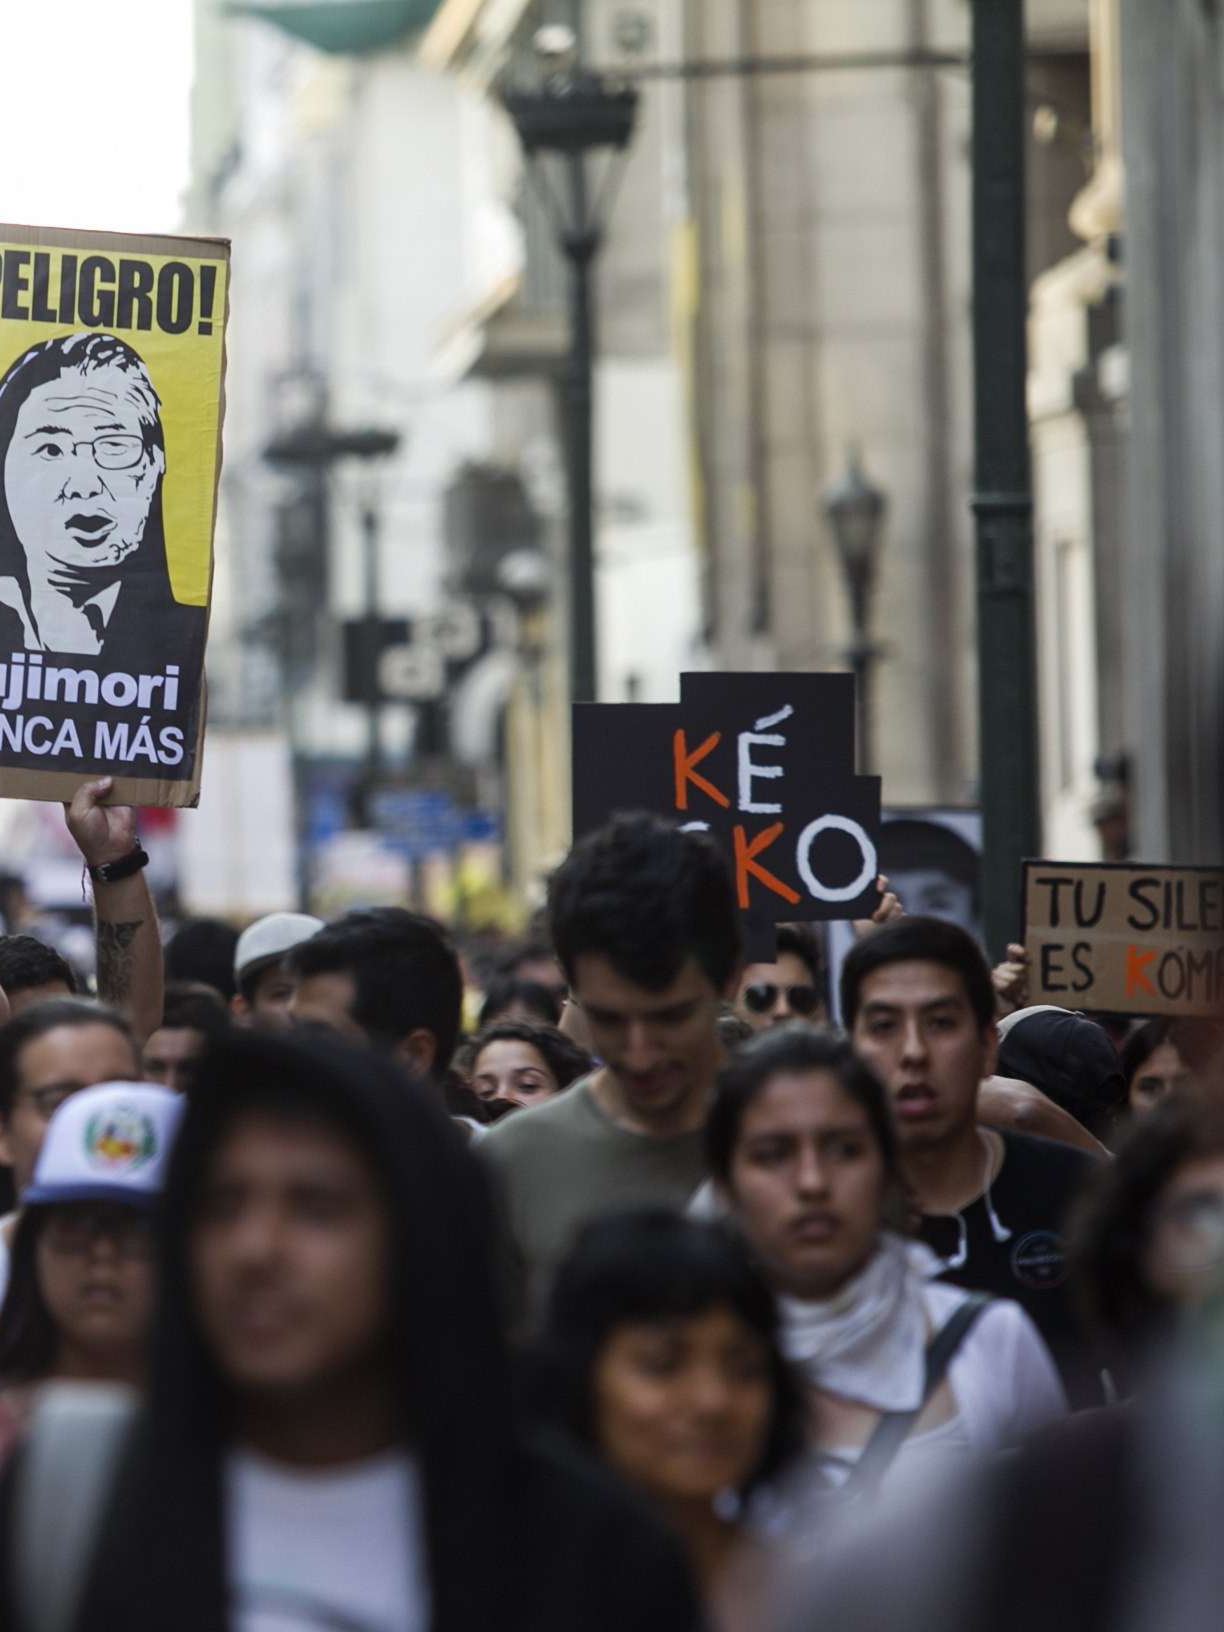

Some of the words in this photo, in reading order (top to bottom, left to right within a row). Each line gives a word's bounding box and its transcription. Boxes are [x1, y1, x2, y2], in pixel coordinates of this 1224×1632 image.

[94, 716, 184, 765] MÁS
[673, 704, 794, 813] KÉ
[679, 814, 877, 908] KO
[1035, 877, 1106, 928] TU
[1127, 877, 1224, 931] SILE
[1041, 942, 1094, 992] ES
